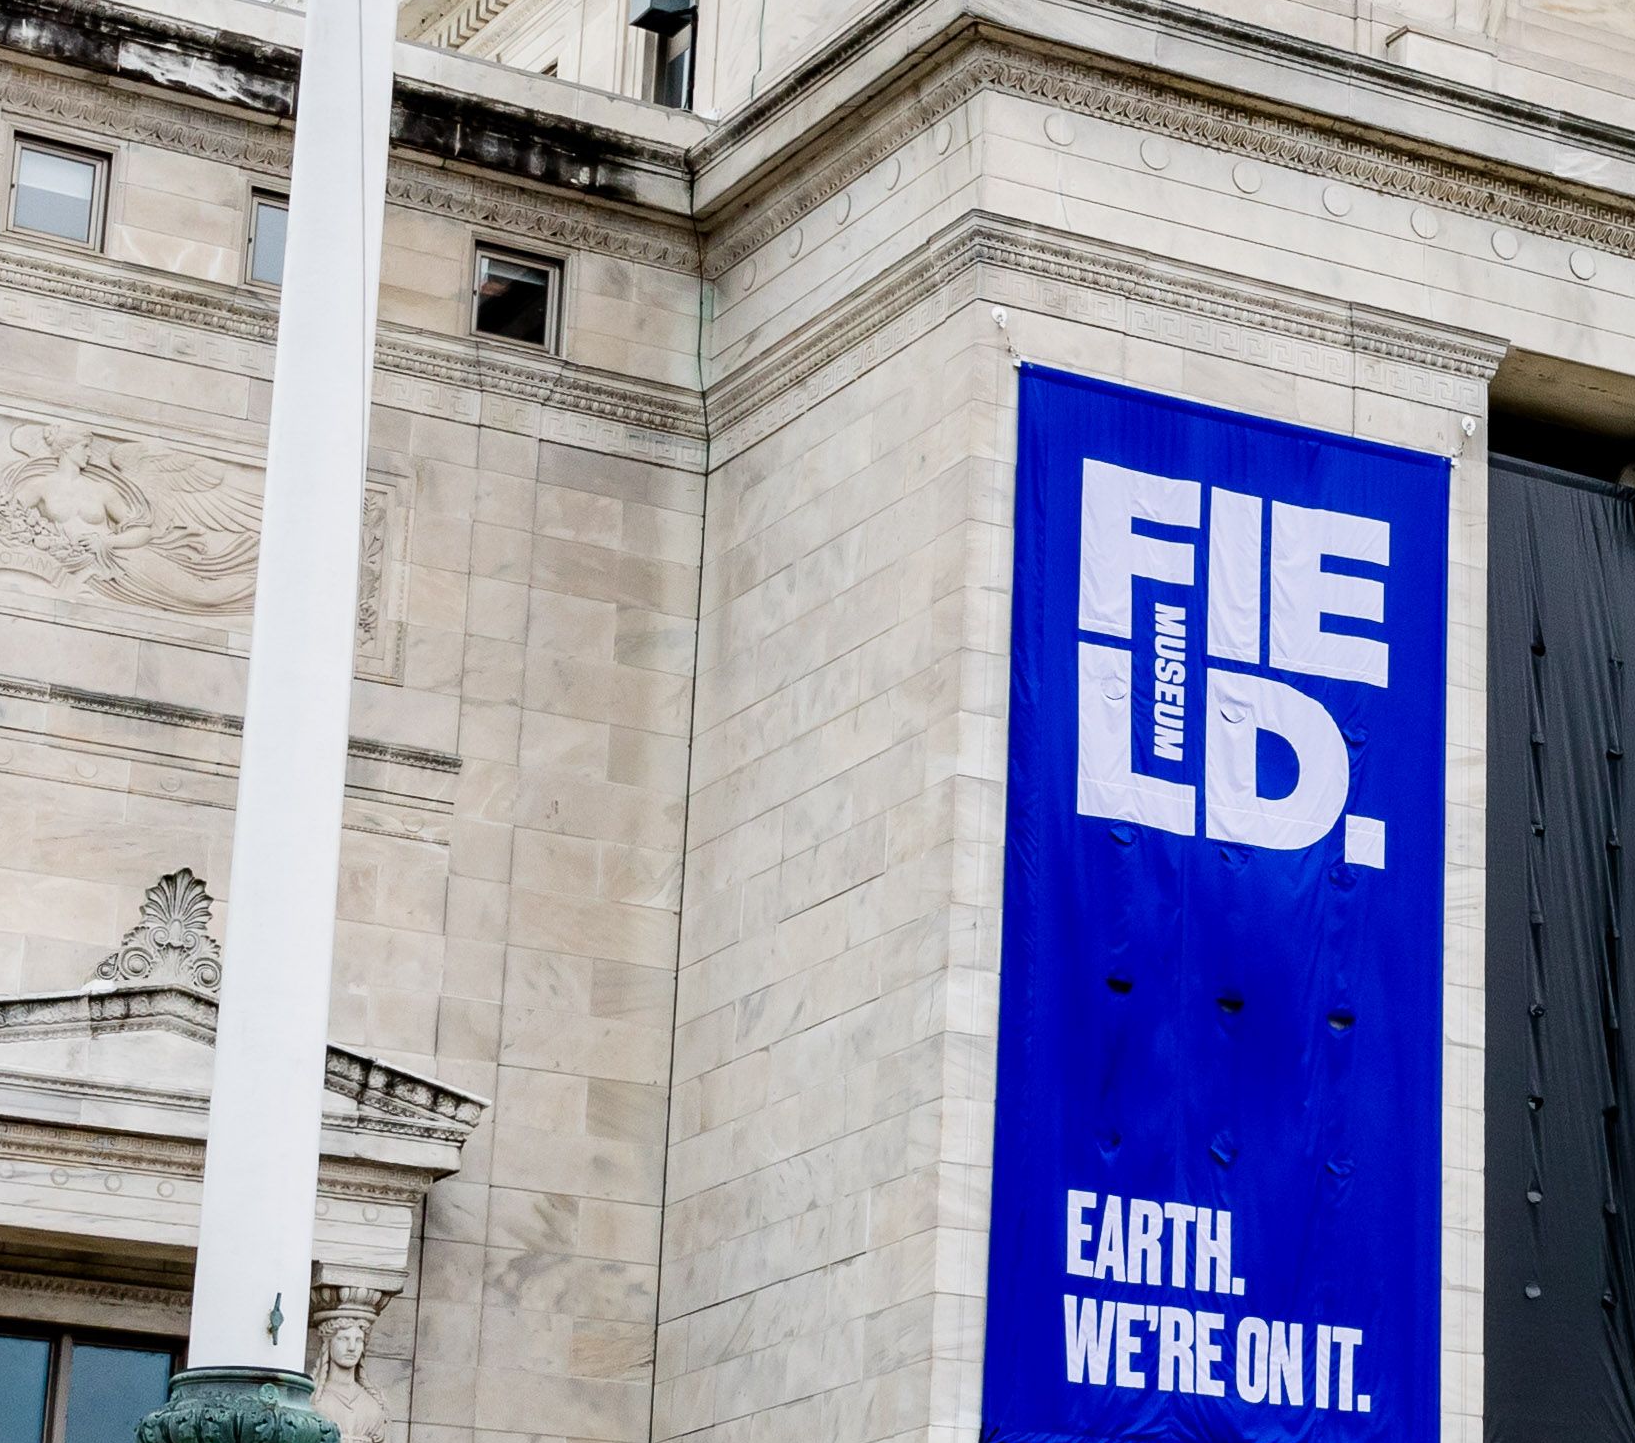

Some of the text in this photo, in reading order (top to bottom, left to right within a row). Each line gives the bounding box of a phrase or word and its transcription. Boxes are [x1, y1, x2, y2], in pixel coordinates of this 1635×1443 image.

[1153, 602, 1186, 761] MUSEUM
[1067, 1190, 1245, 1296] EARTH.
[1064, 1294, 1371, 1413] WE'RE ON IT.
